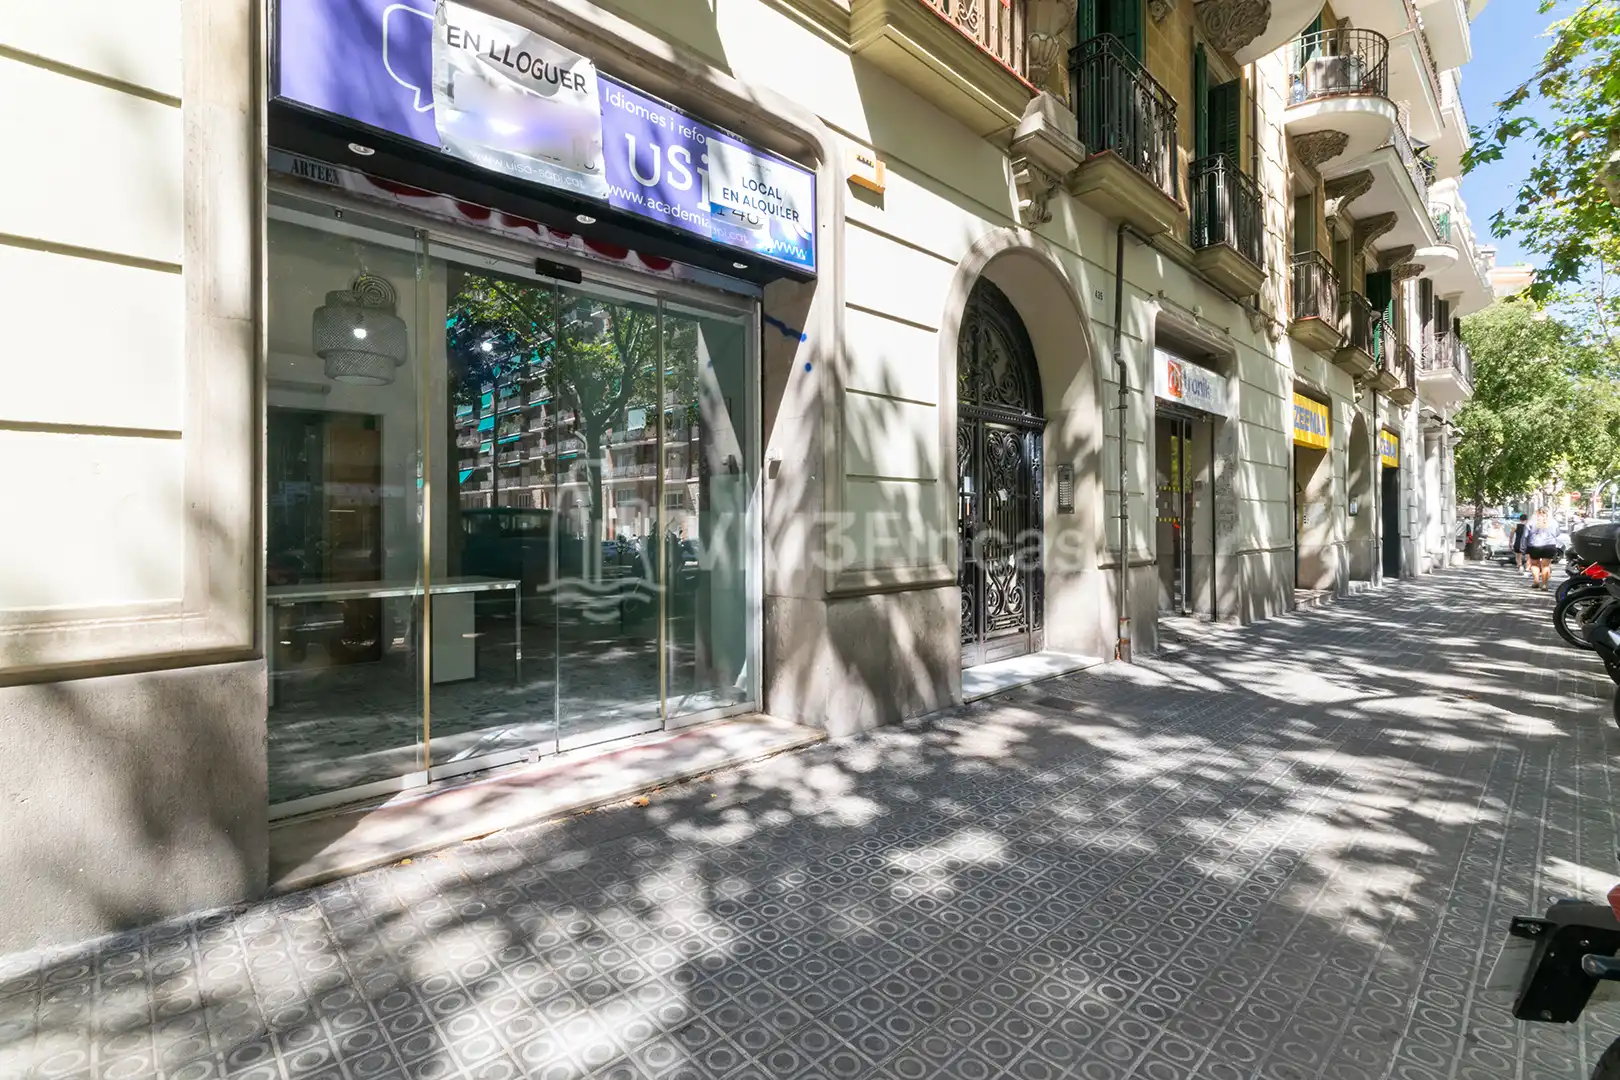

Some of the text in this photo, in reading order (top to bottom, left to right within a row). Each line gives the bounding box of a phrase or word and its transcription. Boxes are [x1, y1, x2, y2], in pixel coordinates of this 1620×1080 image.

[446, 25, 588, 94] EN LLOGUER
[605, 86, 667, 128] Idiomes
[723, 187, 740, 203] EN
[742, 195, 800, 223] ALQUILER
[742, 176, 783, 202] LOCAL
